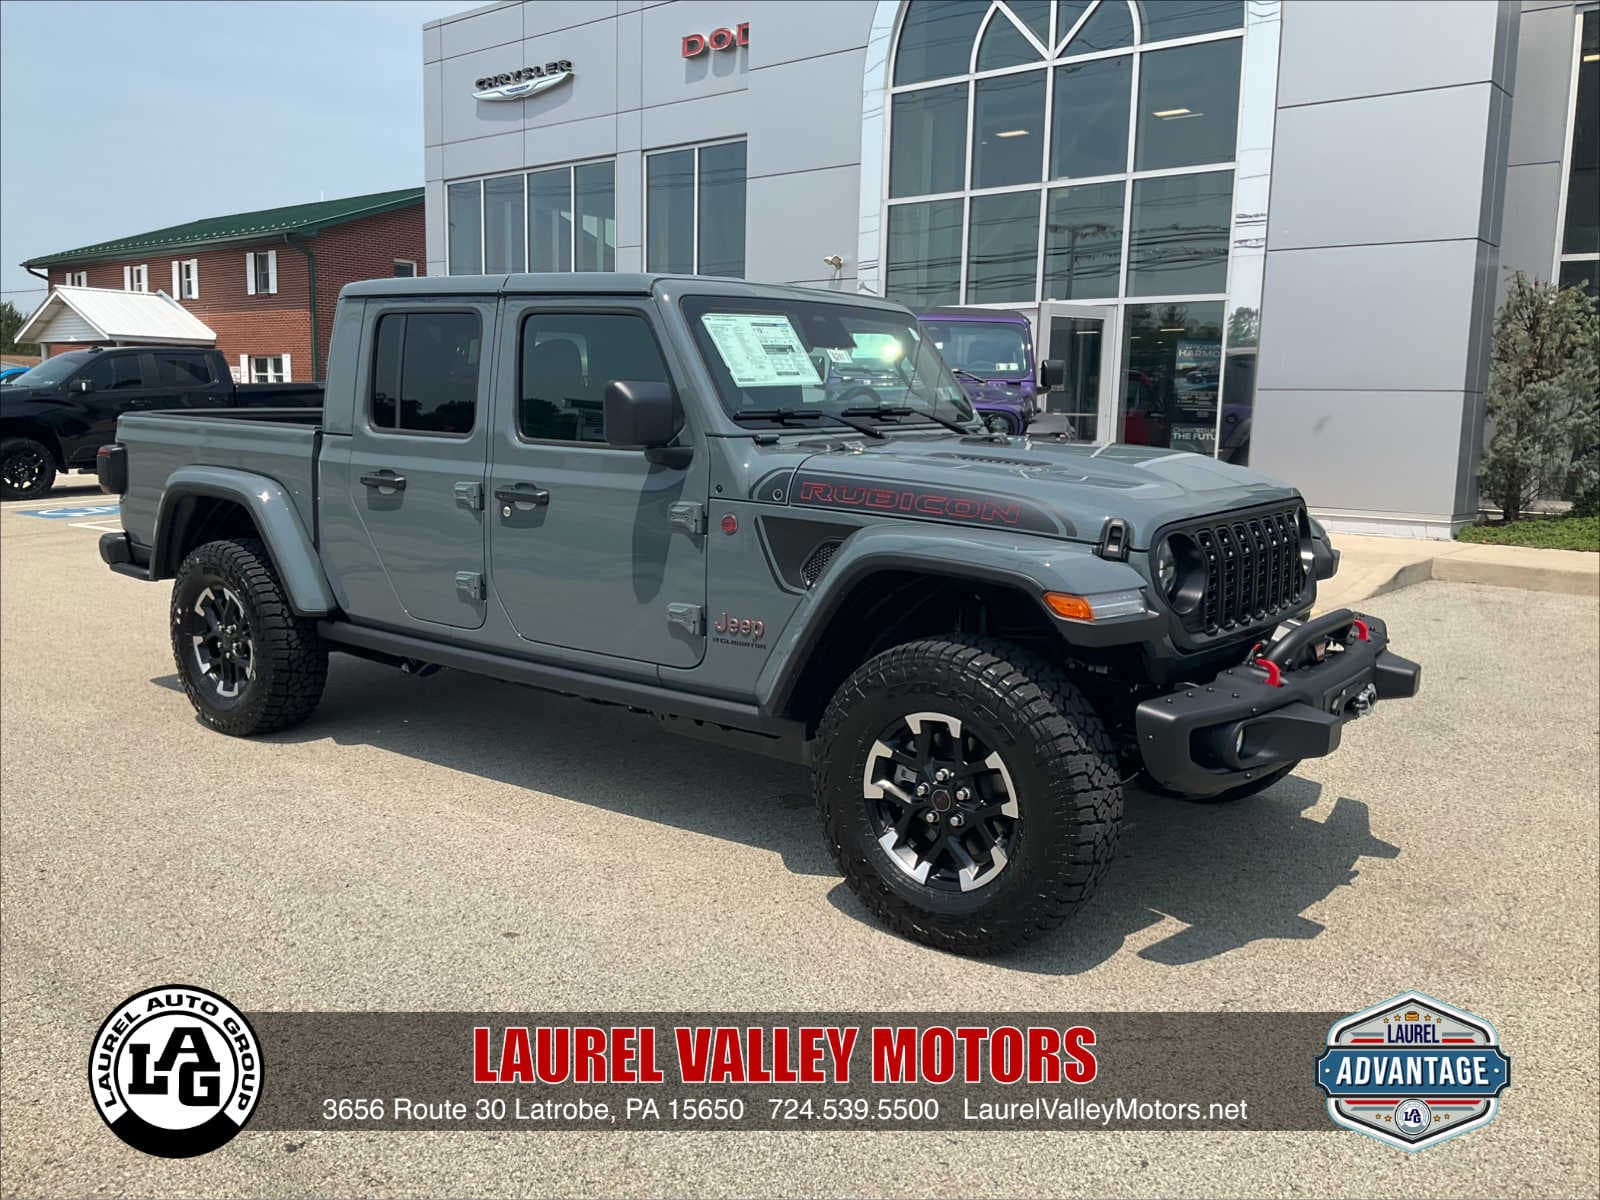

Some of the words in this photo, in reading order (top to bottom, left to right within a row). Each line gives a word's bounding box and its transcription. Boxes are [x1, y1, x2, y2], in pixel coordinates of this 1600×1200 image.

[475, 59, 573, 90] CHRYSLER
[799, 481, 1023, 524] RUBICON
[714, 611, 766, 641] Jeep
